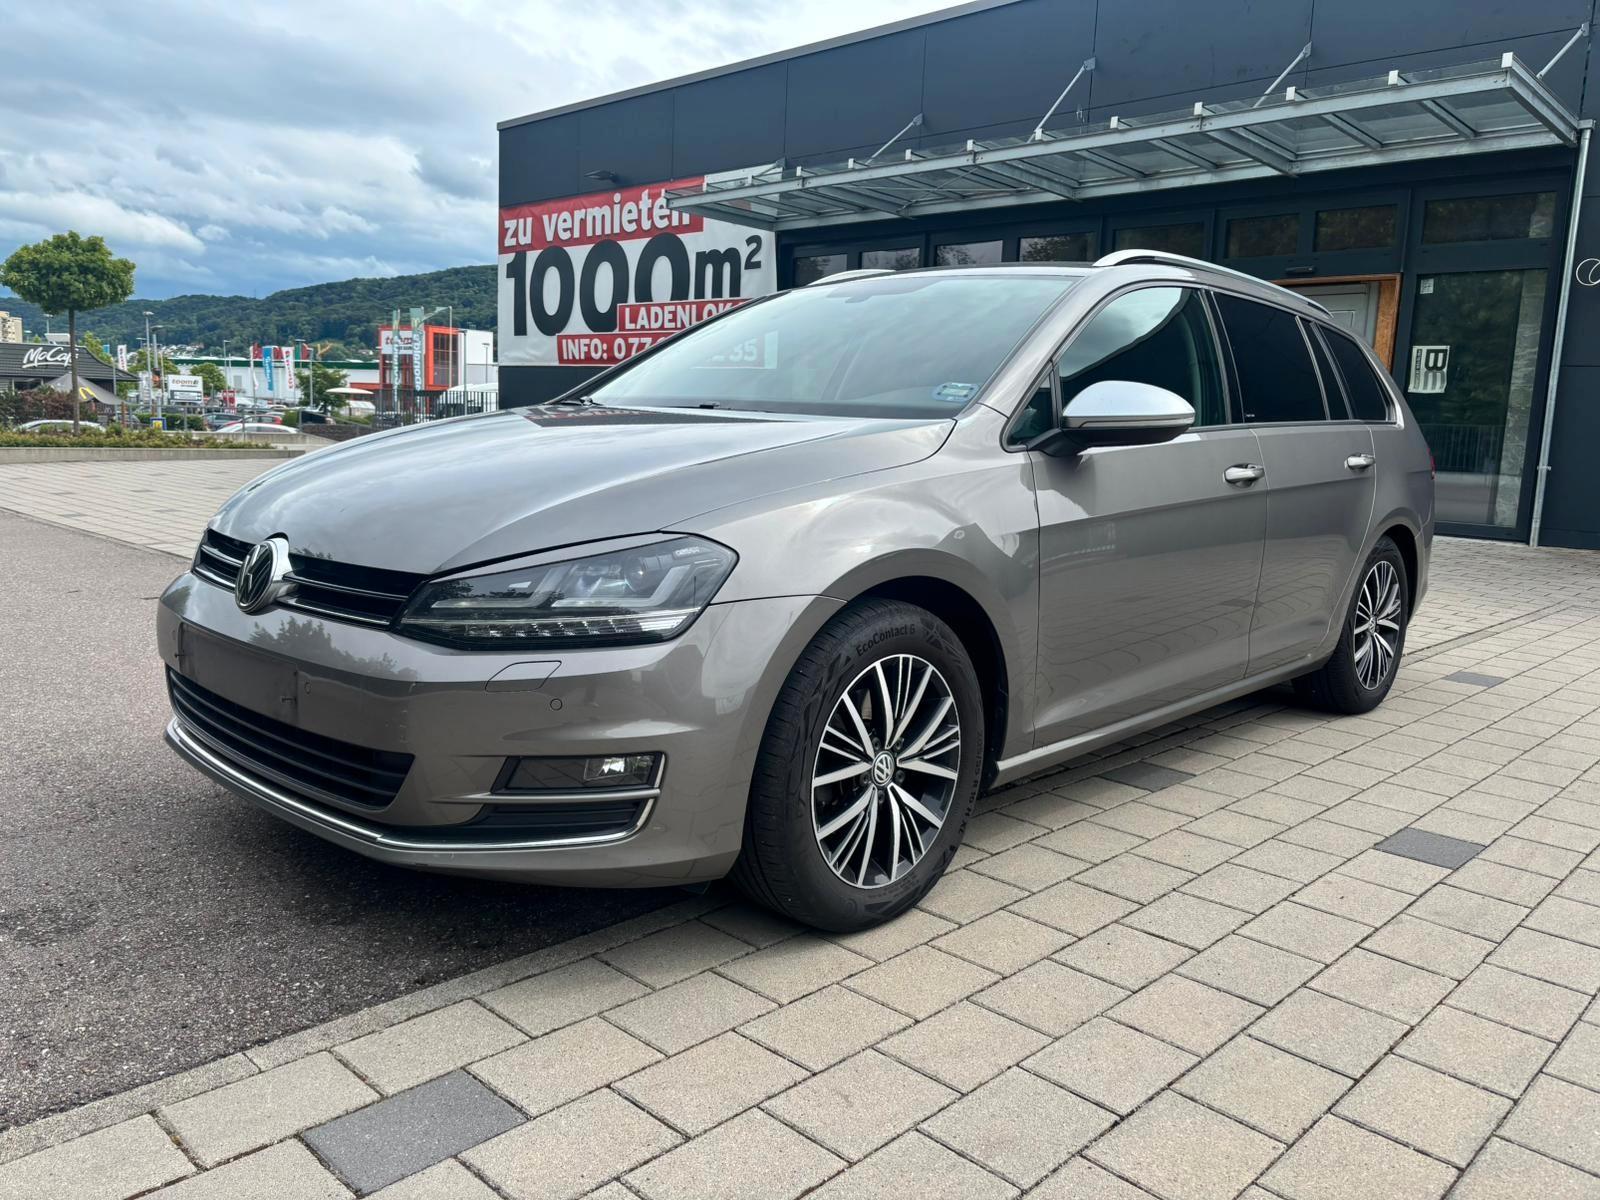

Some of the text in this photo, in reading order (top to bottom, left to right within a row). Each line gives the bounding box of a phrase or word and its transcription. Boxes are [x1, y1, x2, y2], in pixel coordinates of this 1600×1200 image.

[503, 216, 532, 247] zu
[624, 301, 743, 332] LADENLOK
[23, 346, 79, 368] McCaf
[562, 338, 608, 360] INFO:
[855, 625, 908, 656] EcoContact
